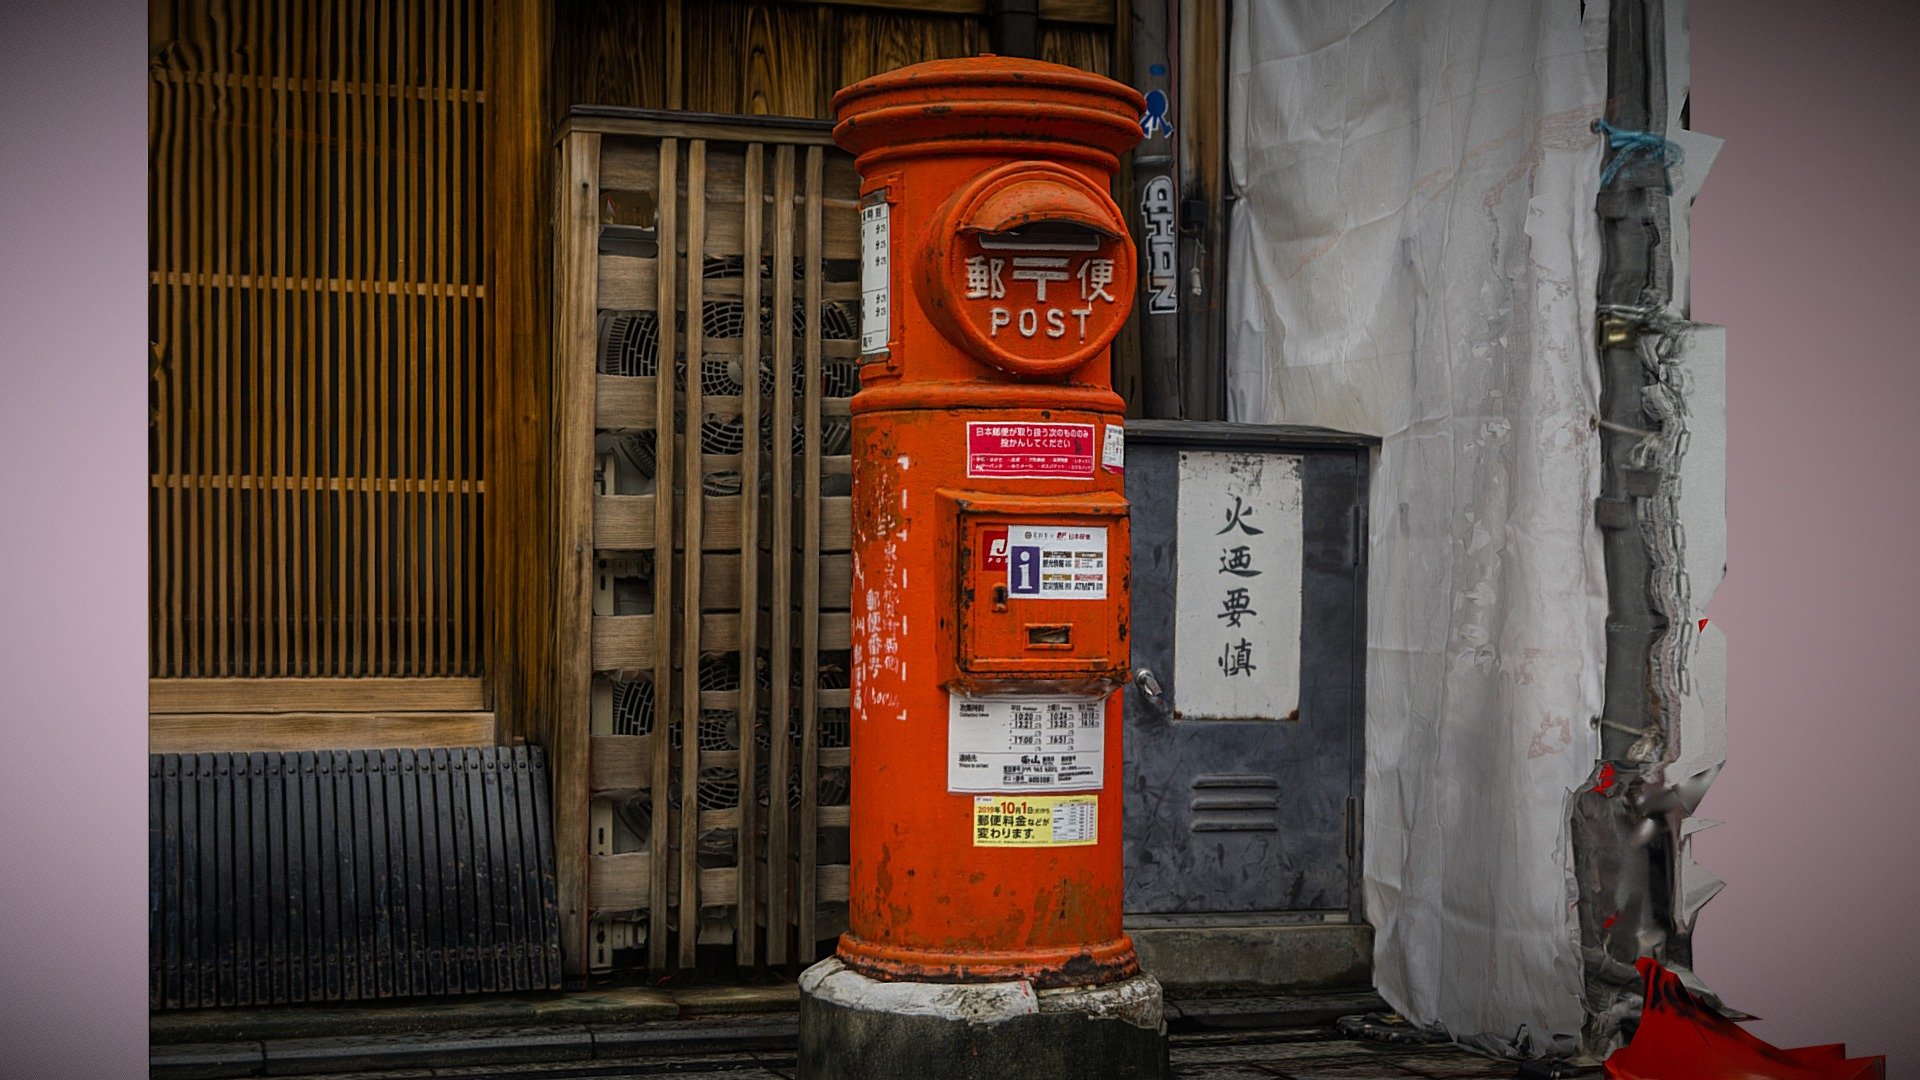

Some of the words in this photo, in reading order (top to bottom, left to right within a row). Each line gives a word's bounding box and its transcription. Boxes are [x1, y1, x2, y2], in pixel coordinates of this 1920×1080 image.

[990, 306, 1092, 340] POST
[976, 427, 1089, 438] 日本郵便が取り扱う次のもののみ
[1000, 438, 1071, 448] 投かんしてください
[978, 815, 1049, 827] 郵便料金などが
[977, 828, 1035, 839] 変わります。
